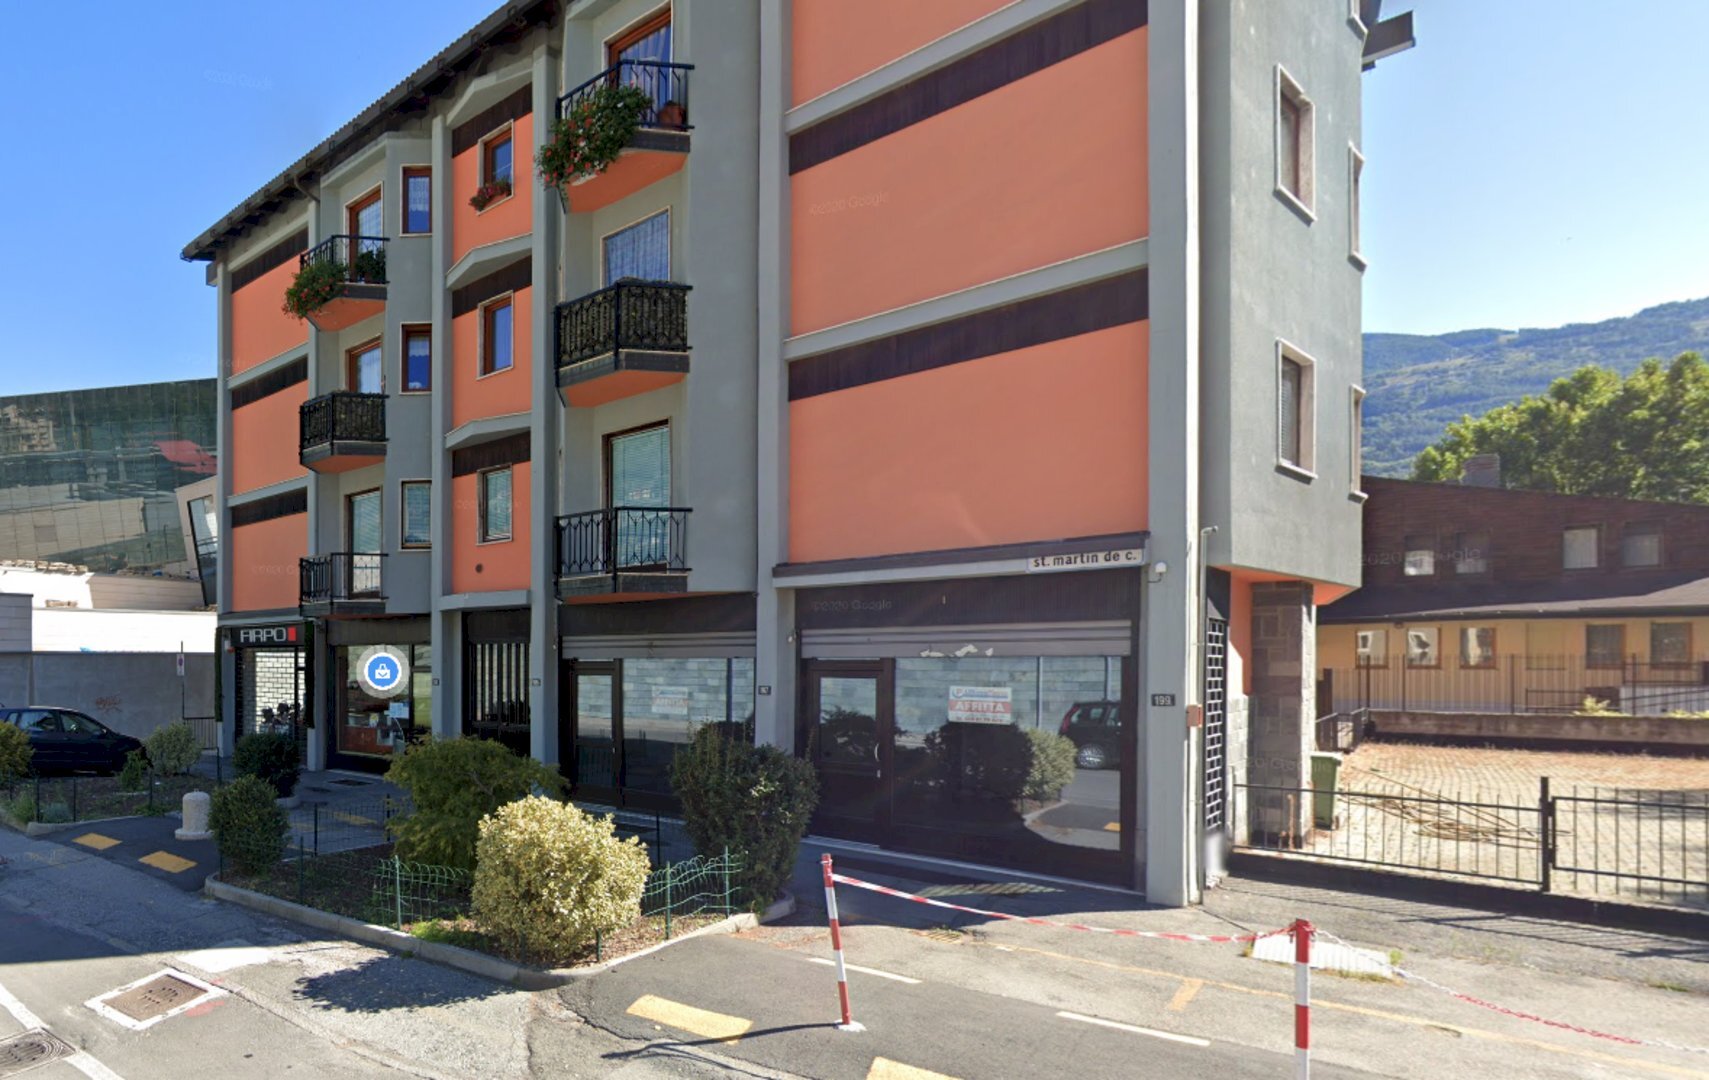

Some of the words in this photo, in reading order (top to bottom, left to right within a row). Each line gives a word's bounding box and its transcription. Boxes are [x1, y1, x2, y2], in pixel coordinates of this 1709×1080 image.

[1033, 557, 1050, 568] st.
[1053, 552, 1098, 566] martin
[1104, 550, 1120, 562] de
[1125, 551, 1137, 561] c.
[955, 701, 1005, 713] AFFITTA
